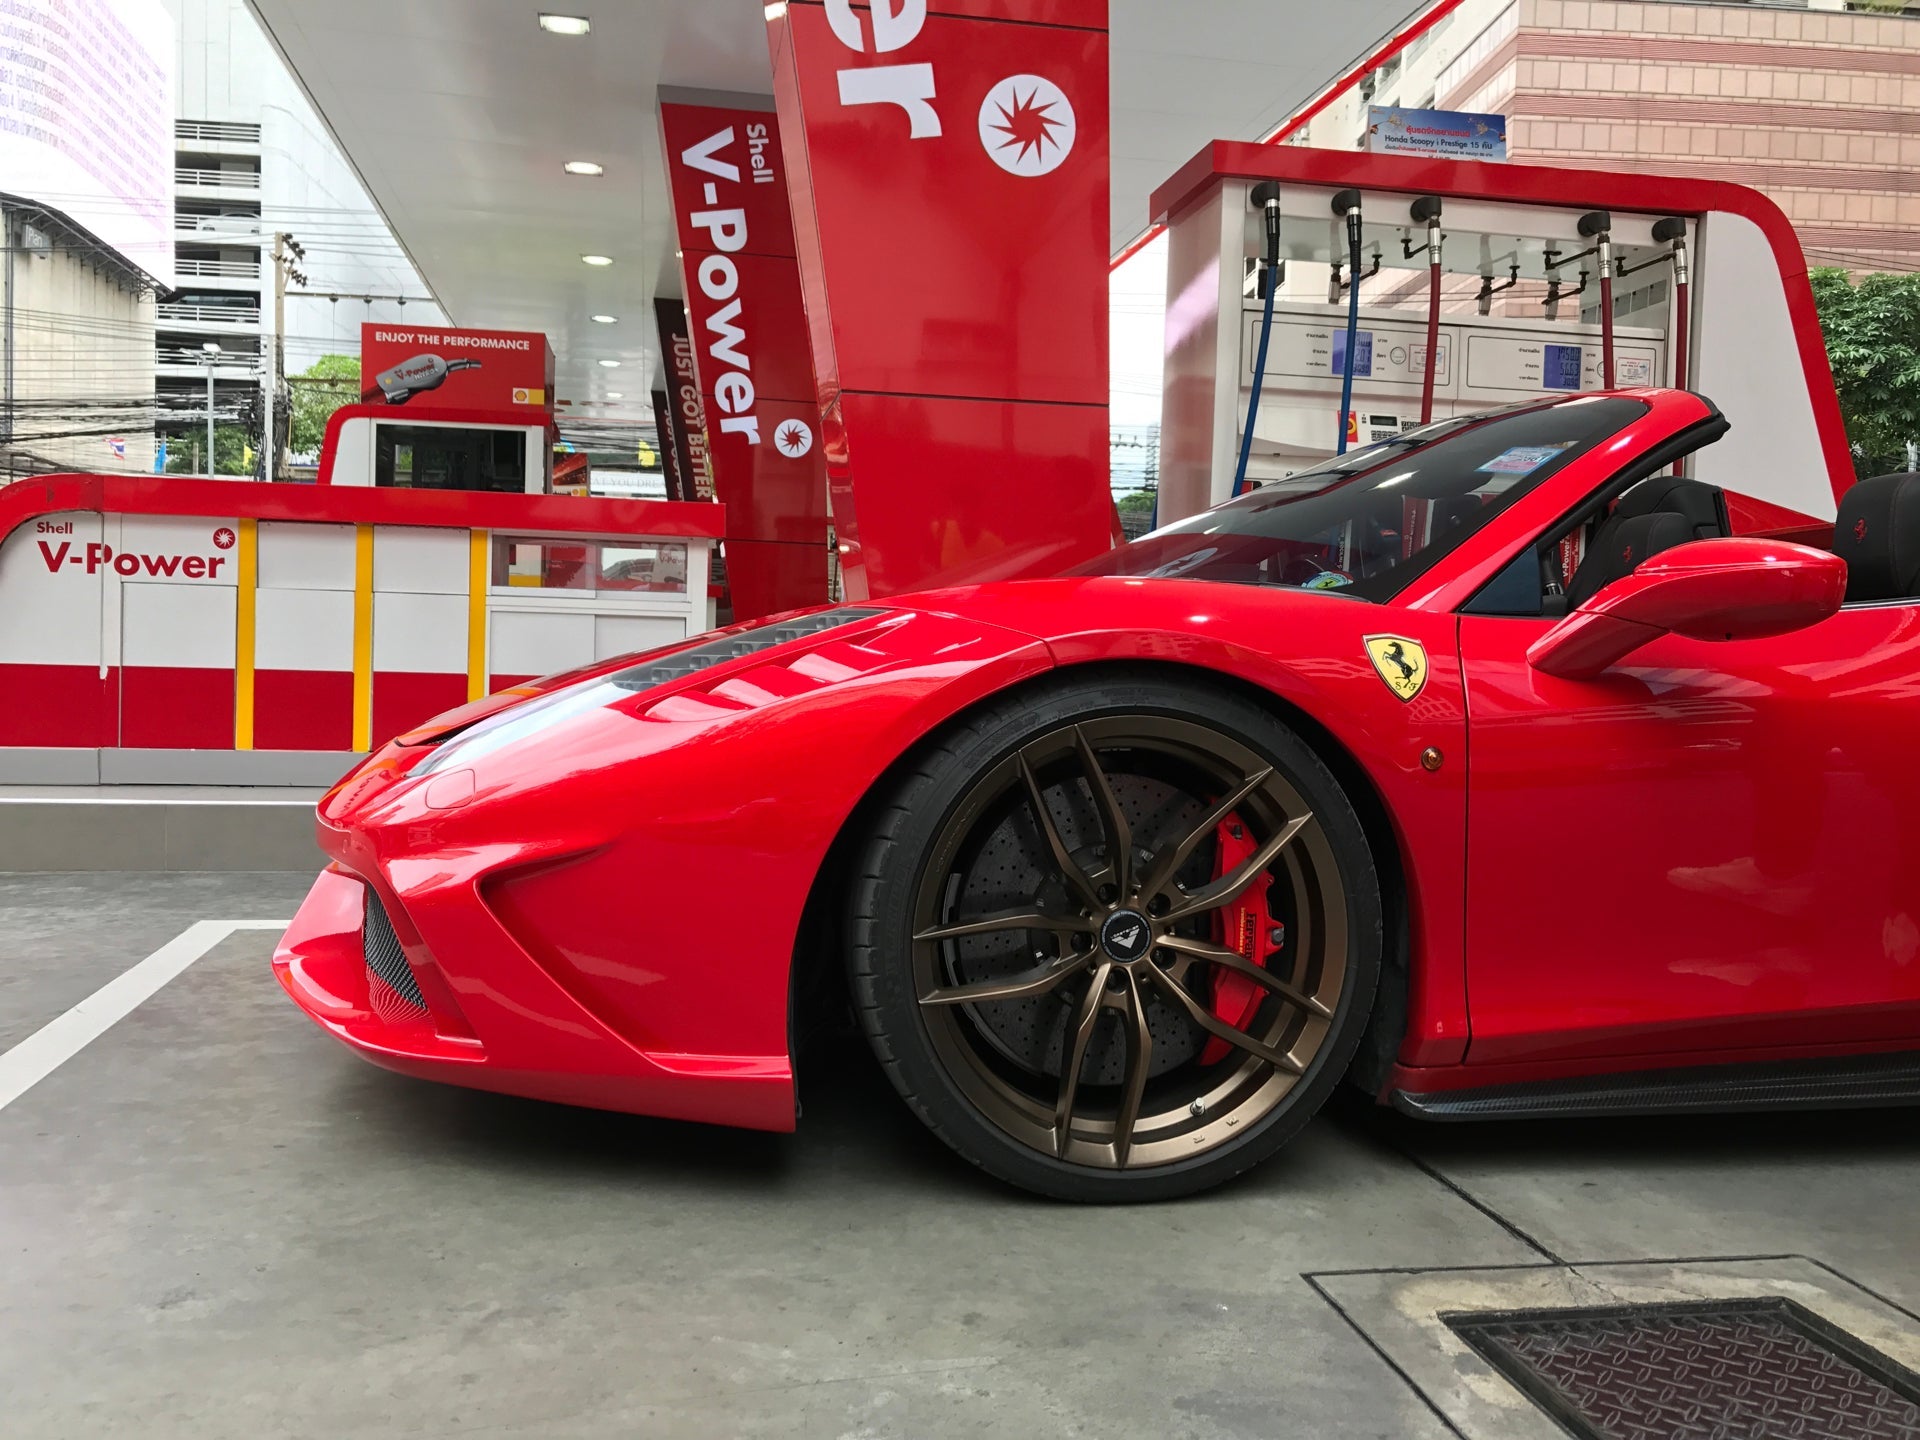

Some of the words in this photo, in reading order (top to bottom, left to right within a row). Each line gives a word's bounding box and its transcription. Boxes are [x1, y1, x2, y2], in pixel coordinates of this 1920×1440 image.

[746, 123, 775, 184] Shell
[1384, 135, 1408, 144] Honda
[1410, 136, 1435, 148] Scoopy
[1441, 139, 1468, 149] Prestige
[1470, 141, 1479, 149] 15
[681, 125, 760, 445] V-Power
[375, 331, 415, 343] ENJOY
[417, 334, 440, 345] THE
[443, 336, 530, 351] PERFORMANCE
[671, 333, 694, 379] JUST
[680, 385, 701, 428] GOT
[687, 433, 712, 498] BETTER
[36, 522, 74, 535] Shell
[37, 540, 226, 579] V-Power
[1395, 681, 1402, 690] S
